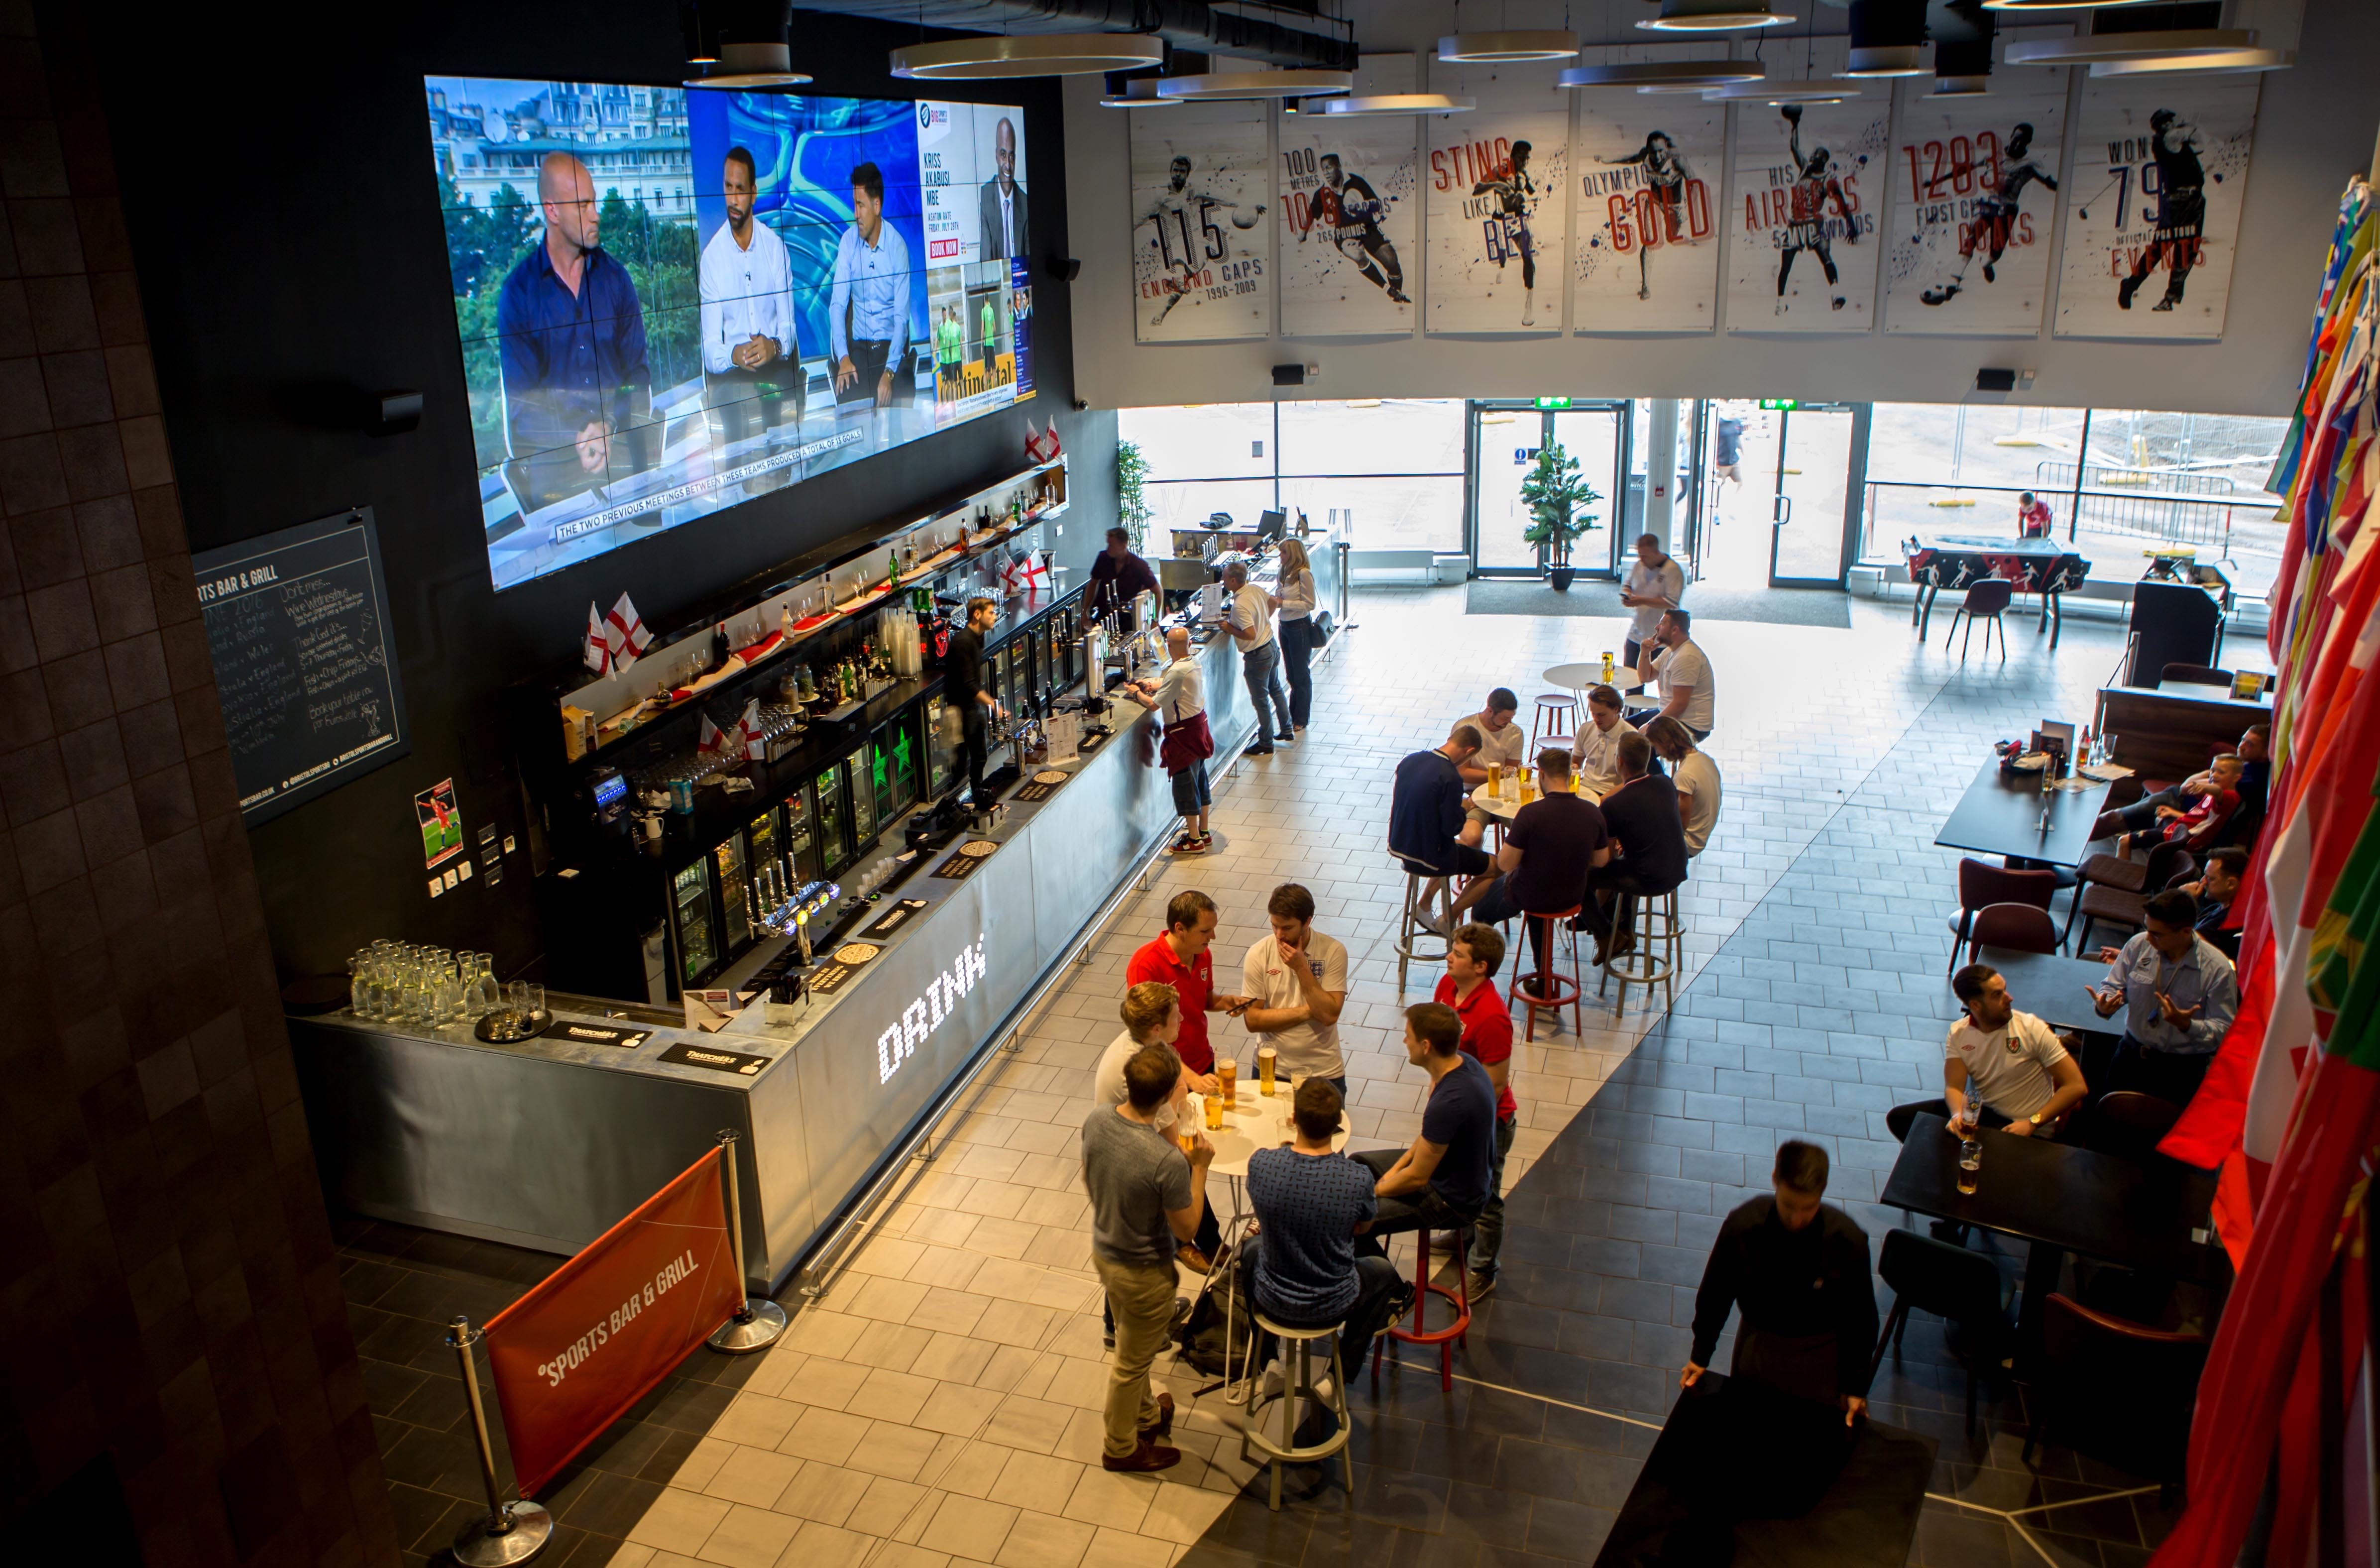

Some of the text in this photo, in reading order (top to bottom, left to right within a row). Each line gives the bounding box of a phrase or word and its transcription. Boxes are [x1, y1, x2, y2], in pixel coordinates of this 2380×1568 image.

[924, 153, 941, 168] KRISS
[1283, 148, 1317, 177] 100
[1431, 137, 1513, 191] STING
[2108, 137, 2148, 164] WON
[926, 171, 950, 187] AKABUSI
[1584, 164, 1649, 197] OLYMPIC
[1769, 164, 1794, 186] HIS
[1903, 131, 1999, 203] 1283
[1291, 175, 1319, 190] METRES
[2108, 162, 2166, 230] 79
[926, 191, 939, 206] MBE
[1281, 187, 1339, 233] 10.8
[1343, 197, 1391, 214] ECODS
[1463, 190, 1505, 220] LIKE A
[1746, 175, 1859, 230] AIRNESS
[928, 212, 941, 221] ASHTON
[1608, 179, 1712, 252] GOLD
[1917, 203, 1955, 225] FIRST
[1149, 202, 1227, 272] 115
[1317, 224, 1366, 243] 265 POUNDS
[1483, 213, 1535, 261] BEE
[1773, 230, 1781, 248] 5
[1959, 213, 2034, 255] GOALS
[2116, 225, 2196, 245] OFFICIAL PGA TOUR
[931, 242, 945, 257] BOOK
[946, 240, 956, 255] NOW
[2111, 236, 2206, 277] EVENTS
[1141, 259, 1262, 299] ENGLAND CAPS
[1206, 280, 1256, 300] 1996-2009
[560, 523, 577, 538] THE
[579, 517, 600, 532] TWO
[602, 503, 644, 523] PREVIOUS
[646, 489, 684, 509] MEETINGS
[685, 477, 720, 496] BETWEEN
[722, 470, 744, 484] THESE
[745, 462, 766, 476] TEAMS
[767, 450, 800, 469] PRODUCED
[807, 443, 826, 455] TOTAL
[827, 440, 835, 448] OF
[842, 431, 861, 443] GOALS
[215, 575, 239, 597] BAR
[239, 572, 250, 589] &
[249, 563, 279, 586] GRILL
[809, 972, 825, 983] RIDE
[811, 965, 844, 991] EVERYTHING
[832, 970, 848, 982] BREW
[878, 933, 986, 1085] DRINK
[686, 1050, 737, 1063] THATCHERS
[611, 1292, 642, 1337] BAR
[644, 1286, 656, 1308] &
[656, 1248, 699, 1298] GRILL
